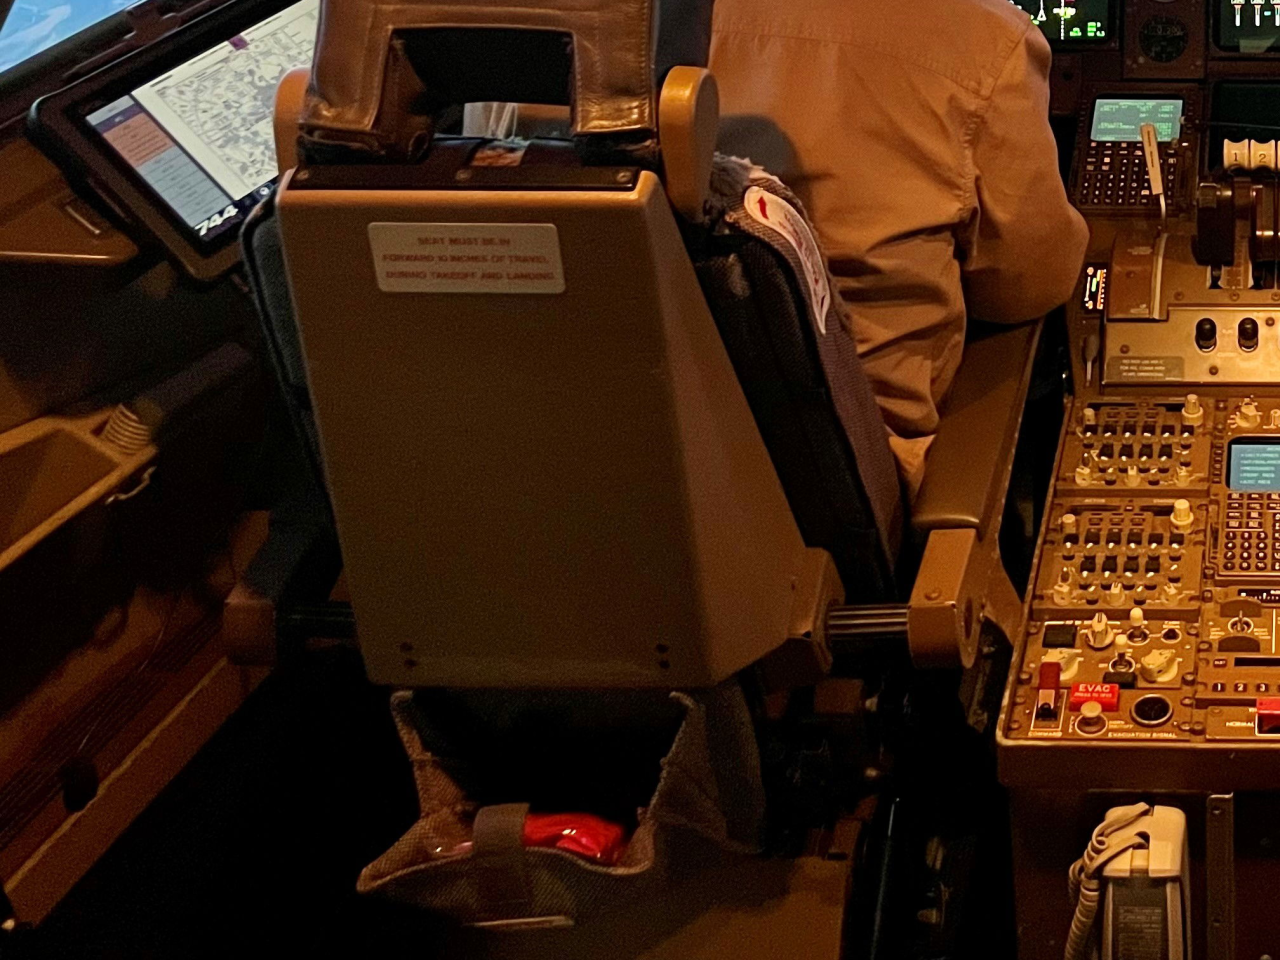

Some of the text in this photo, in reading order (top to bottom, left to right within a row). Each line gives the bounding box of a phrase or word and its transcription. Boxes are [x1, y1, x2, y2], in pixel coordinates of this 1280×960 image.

[1259, 153, 1267, 163] 2
[194, 205, 239, 236] 744
[382, 254, 434, 262] FORWARD
[491, 255, 506, 263] OF
[1079, 683, 1110, 692] EVAC
